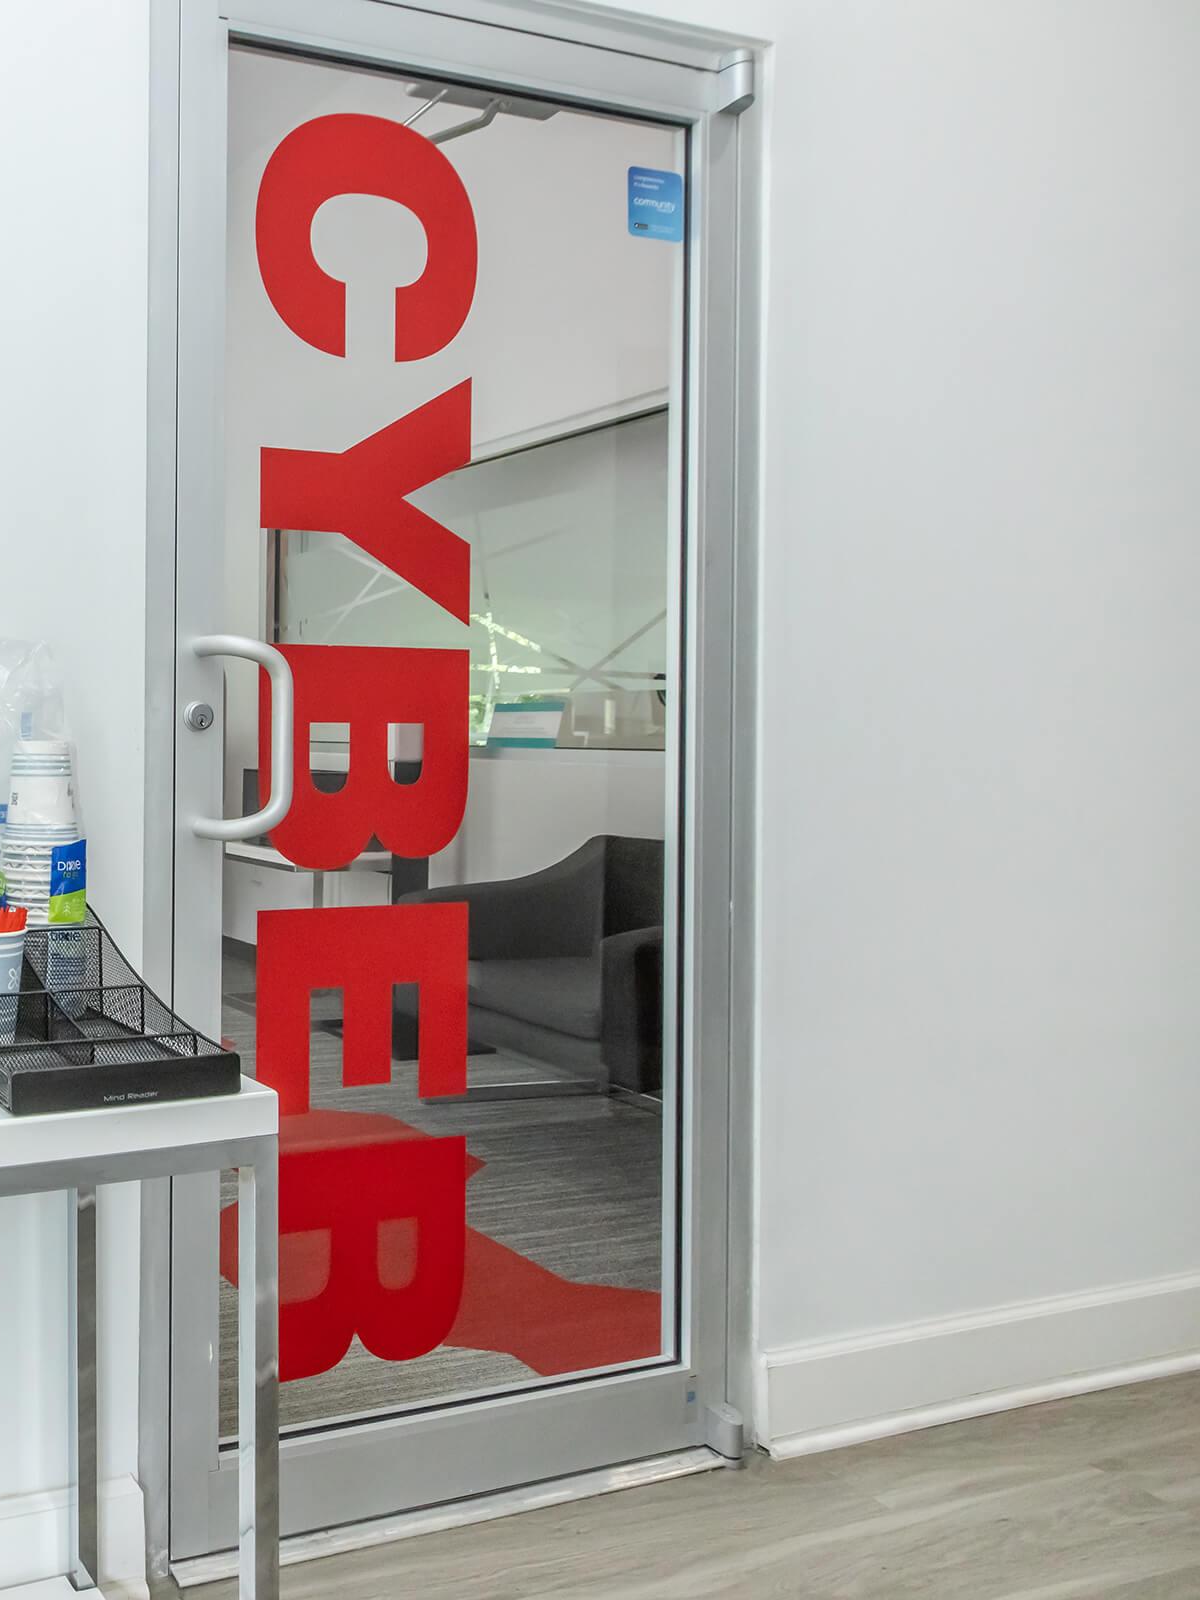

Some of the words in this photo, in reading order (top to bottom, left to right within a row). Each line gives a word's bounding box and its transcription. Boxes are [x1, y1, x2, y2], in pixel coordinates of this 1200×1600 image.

[633, 196, 676, 213] community
[255, 112, 478, 1382] CYBER
[103, 1094, 125, 1103] Mind
[127, 1090, 159, 1100] Reader
